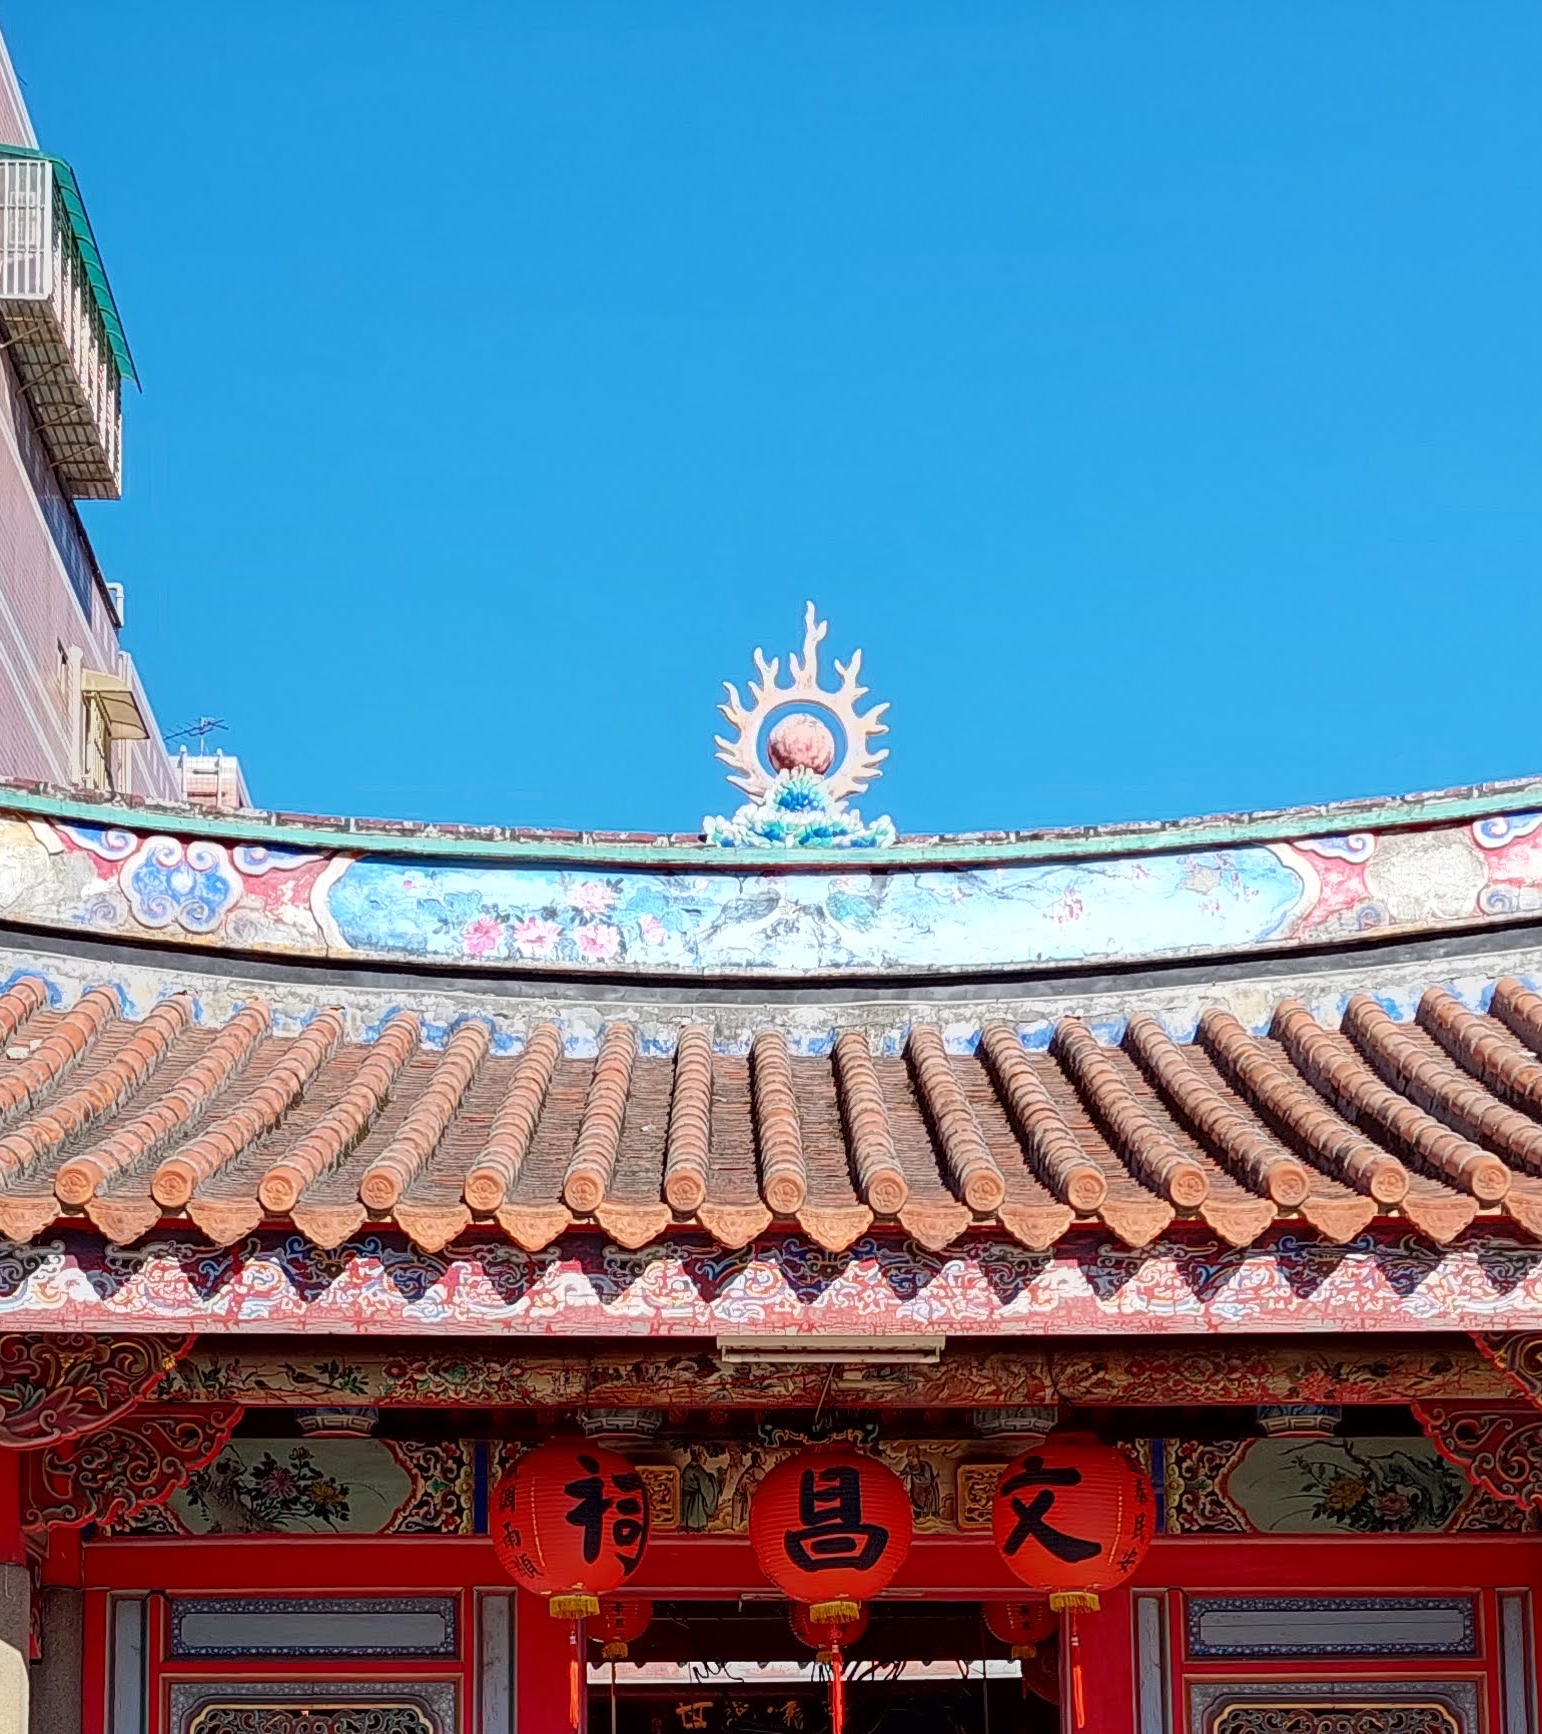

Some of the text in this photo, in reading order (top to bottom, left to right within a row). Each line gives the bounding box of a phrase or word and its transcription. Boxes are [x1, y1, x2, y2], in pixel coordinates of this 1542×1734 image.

[564, 1455, 649, 1577] 祠
[784, 1466, 889, 1572] 昌
[1000, 1456, 1102, 1563] 文
